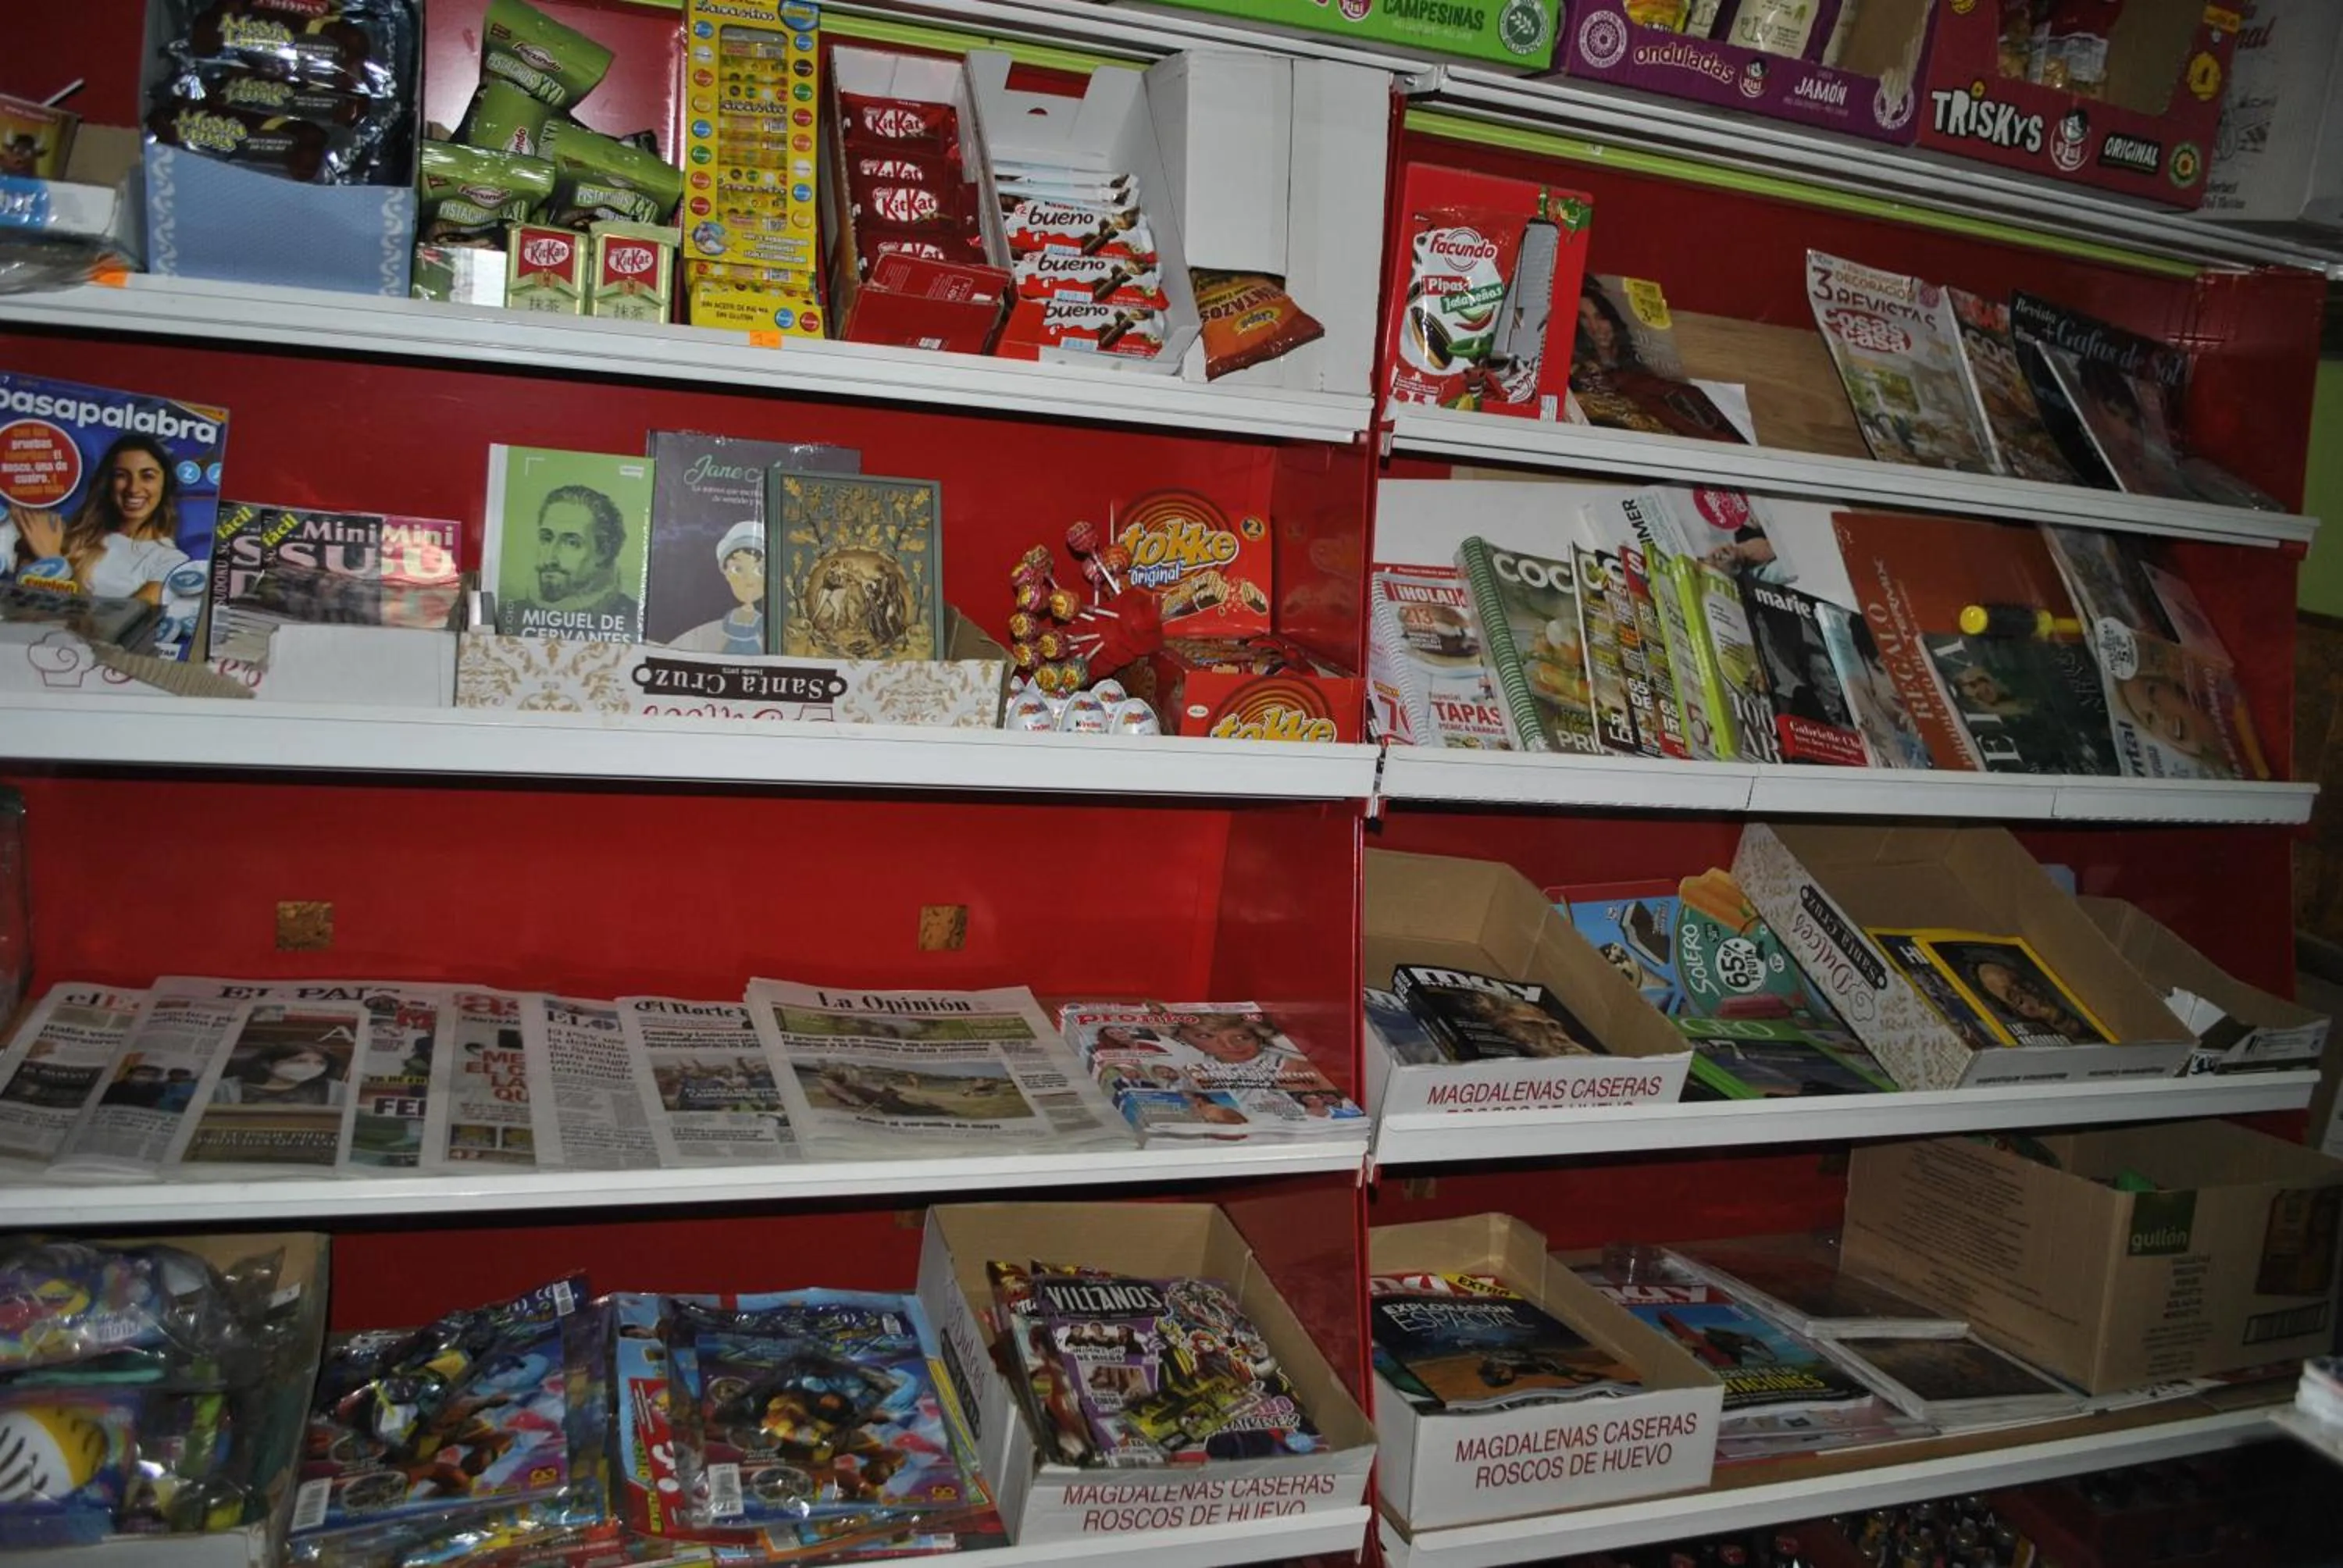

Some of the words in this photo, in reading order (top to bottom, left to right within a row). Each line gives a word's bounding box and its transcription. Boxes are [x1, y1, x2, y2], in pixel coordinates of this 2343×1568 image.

[1383, 0, 1484, 31] CAMPESINAS
[1634, 42, 1734, 84] onduladas
[1794, 76, 1849, 106] JAMÓN
[870, 108, 926, 138] KitKat
[2104, 136, 2159, 167] ORIGINAL
[881, 188, 938, 222] KitKat
[1028, 204, 1095, 226] bueno
[530, 240, 567, 264] KitKat
[615, 248, 651, 272] KitKat
[1429, 233, 1497, 260] Facundo
[1038, 253, 1106, 273] bueno
[1428, 278, 1463, 294] Pipas
[1812, 265, 1833, 301] 3
[1835, 288, 1938, 332] REVISTAS
[1044, 298, 1109, 319] bueno
[2016, 296, 2057, 324] Revista
[303, 519, 376, 543] Mini
[381, 524, 455, 546] Mini
[1621, 497, 1653, 548] IMER
[1130, 561, 1182, 588] Original
[1492, 551, 1574, 594] COC
[1755, 586, 1813, 619] marie
[522, 609, 593, 629] MIGUEL
[601, 614, 625, 632] DE
[1867, 600, 1935, 720] REGALO
[654, 668, 726, 695] Cruz
[742, 675, 825, 699] Santa
[1435, 702, 1502, 727] TAPAS
[1681, 922, 1722, 997] SOLERO
[1720, 941, 1751, 989] 65%
[1743, 949, 1761, 982] FRUTA
[1792, 913, 1854, 996] Dulces
[818, 991, 853, 1010] La
[862, 994, 972, 1016] Opinión
[1427, 1080, 1565, 1106] MAGDALENAS
[1570, 1075, 1664, 1099] CASERAS
[2131, 1224, 2188, 1252] gullón
[1045, 1285, 1164, 1311] VILLANOS
[1454, 1424, 1599, 1463] MAGDALENAS
[1603, 1412, 1698, 1445] CASERAS
[1475, 1455, 1564, 1489] ROSCOS
[1569, 1452, 1596, 1477] DE
[1602, 1441, 1673, 1472] HUEVO
[1063, 1481, 1225, 1506] MAGDALENAS
[1230, 1474, 1336, 1498] CASERAS
[1083, 1505, 1185, 1532] ROSCOS
[1189, 1502, 1225, 1526] DE
